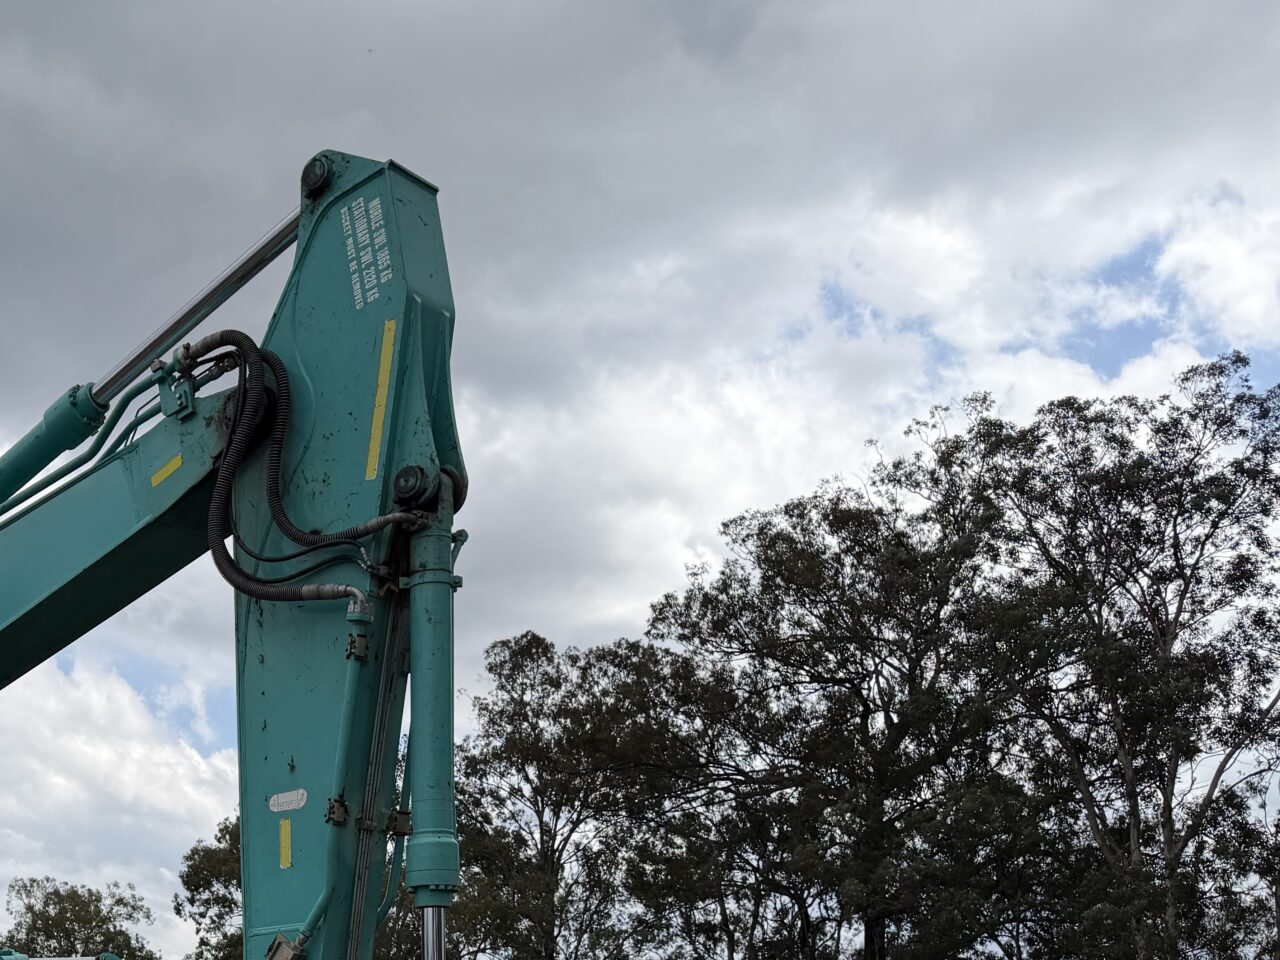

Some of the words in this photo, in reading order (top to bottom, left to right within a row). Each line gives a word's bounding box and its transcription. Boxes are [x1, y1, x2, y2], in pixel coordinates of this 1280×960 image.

[340, 206, 353, 236] BUCKET
[351, 197, 370, 248] STATIONARY
[368, 197, 384, 230] MOBILE
[345, 236, 356, 260] MUST
[373, 228, 387, 249] SWL
[349, 260, 358, 273] BE
[360, 246, 373, 268] SWL
[380, 267, 393, 283] KG
[351, 272, 364, 310] REMOVED
[366, 287, 379, 303] KG
